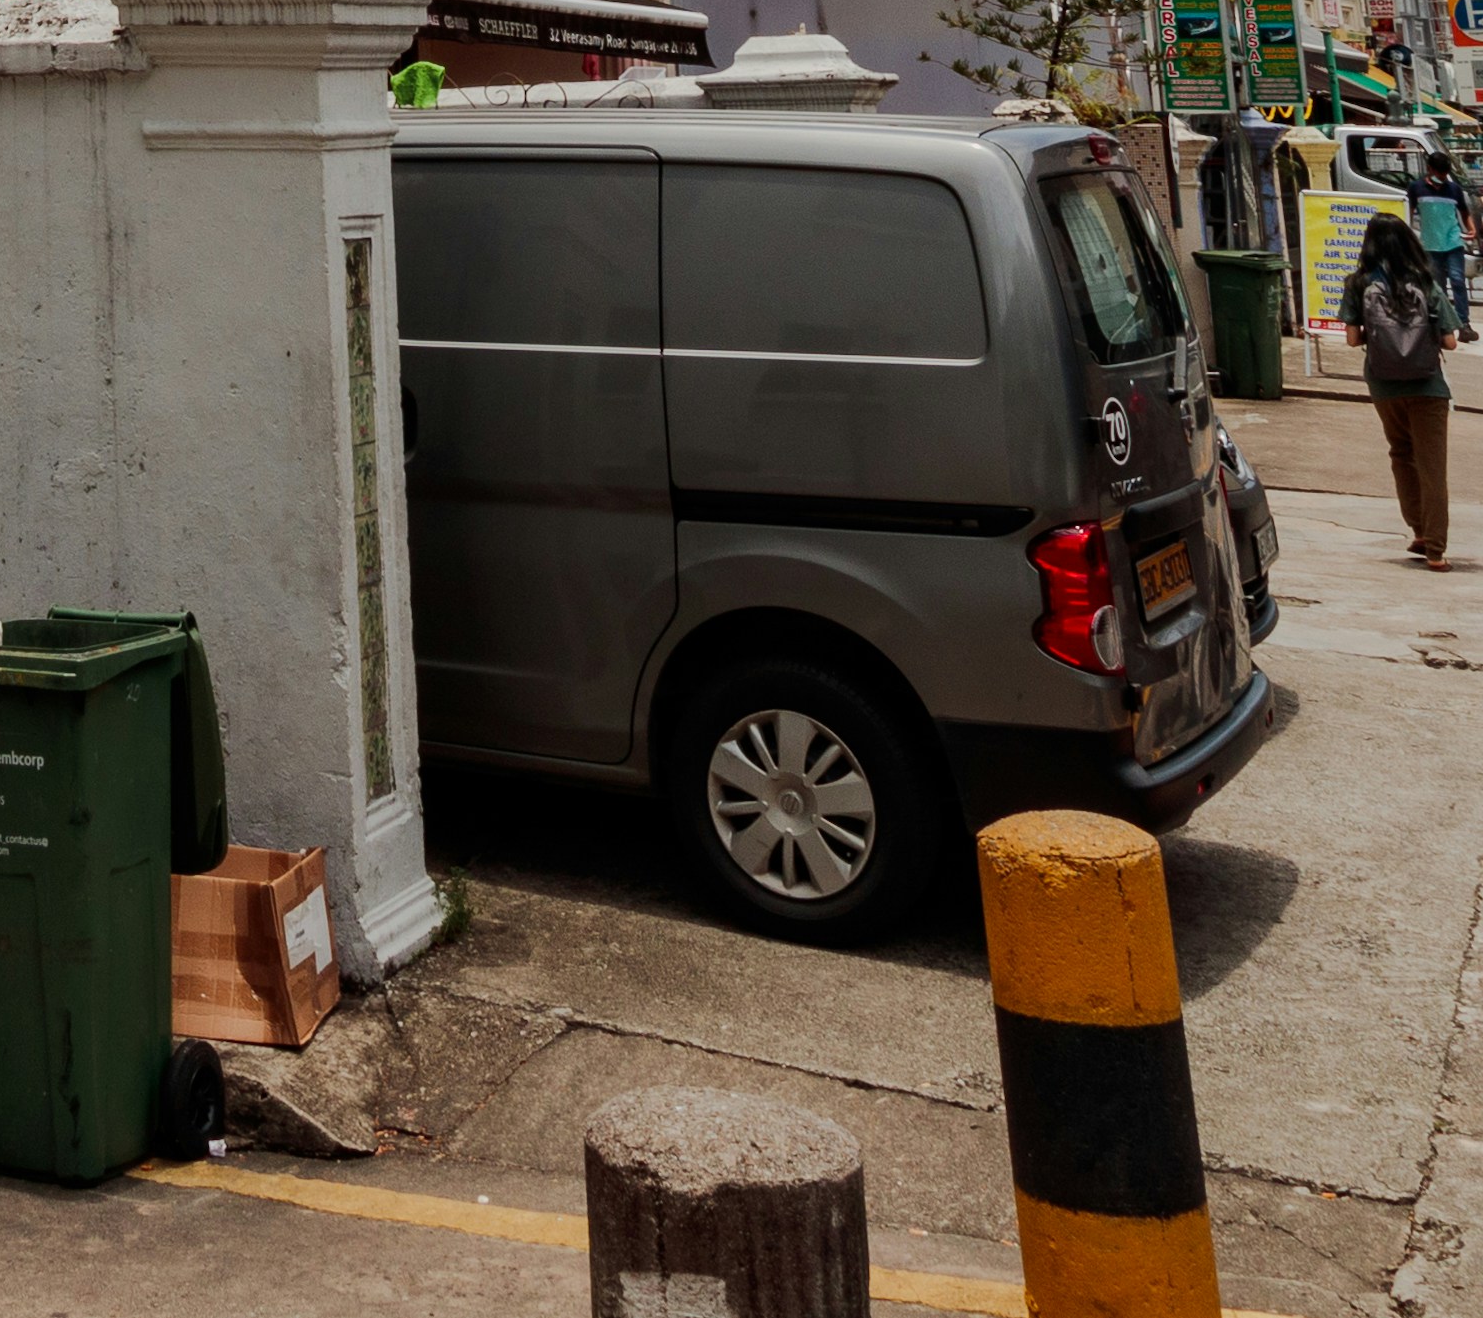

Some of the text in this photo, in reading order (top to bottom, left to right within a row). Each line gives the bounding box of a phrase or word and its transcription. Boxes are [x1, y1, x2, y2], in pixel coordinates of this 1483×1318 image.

[478, 17, 538, 40] SCHAEFFLER
[560, 28, 605, 51] Veerasamy
[1330, 204, 1378, 214] PRINTING
[1329, 215, 1371, 224] SCANNI
[1338, 227, 1365, 236] E-MA
[1325, 239, 1362, 248] LAMINA
[1315, 262, 1358, 272] PASSPOR
[1316, 273, 1345, 282] LICEN
[1106, 411, 1127, 442] 70
